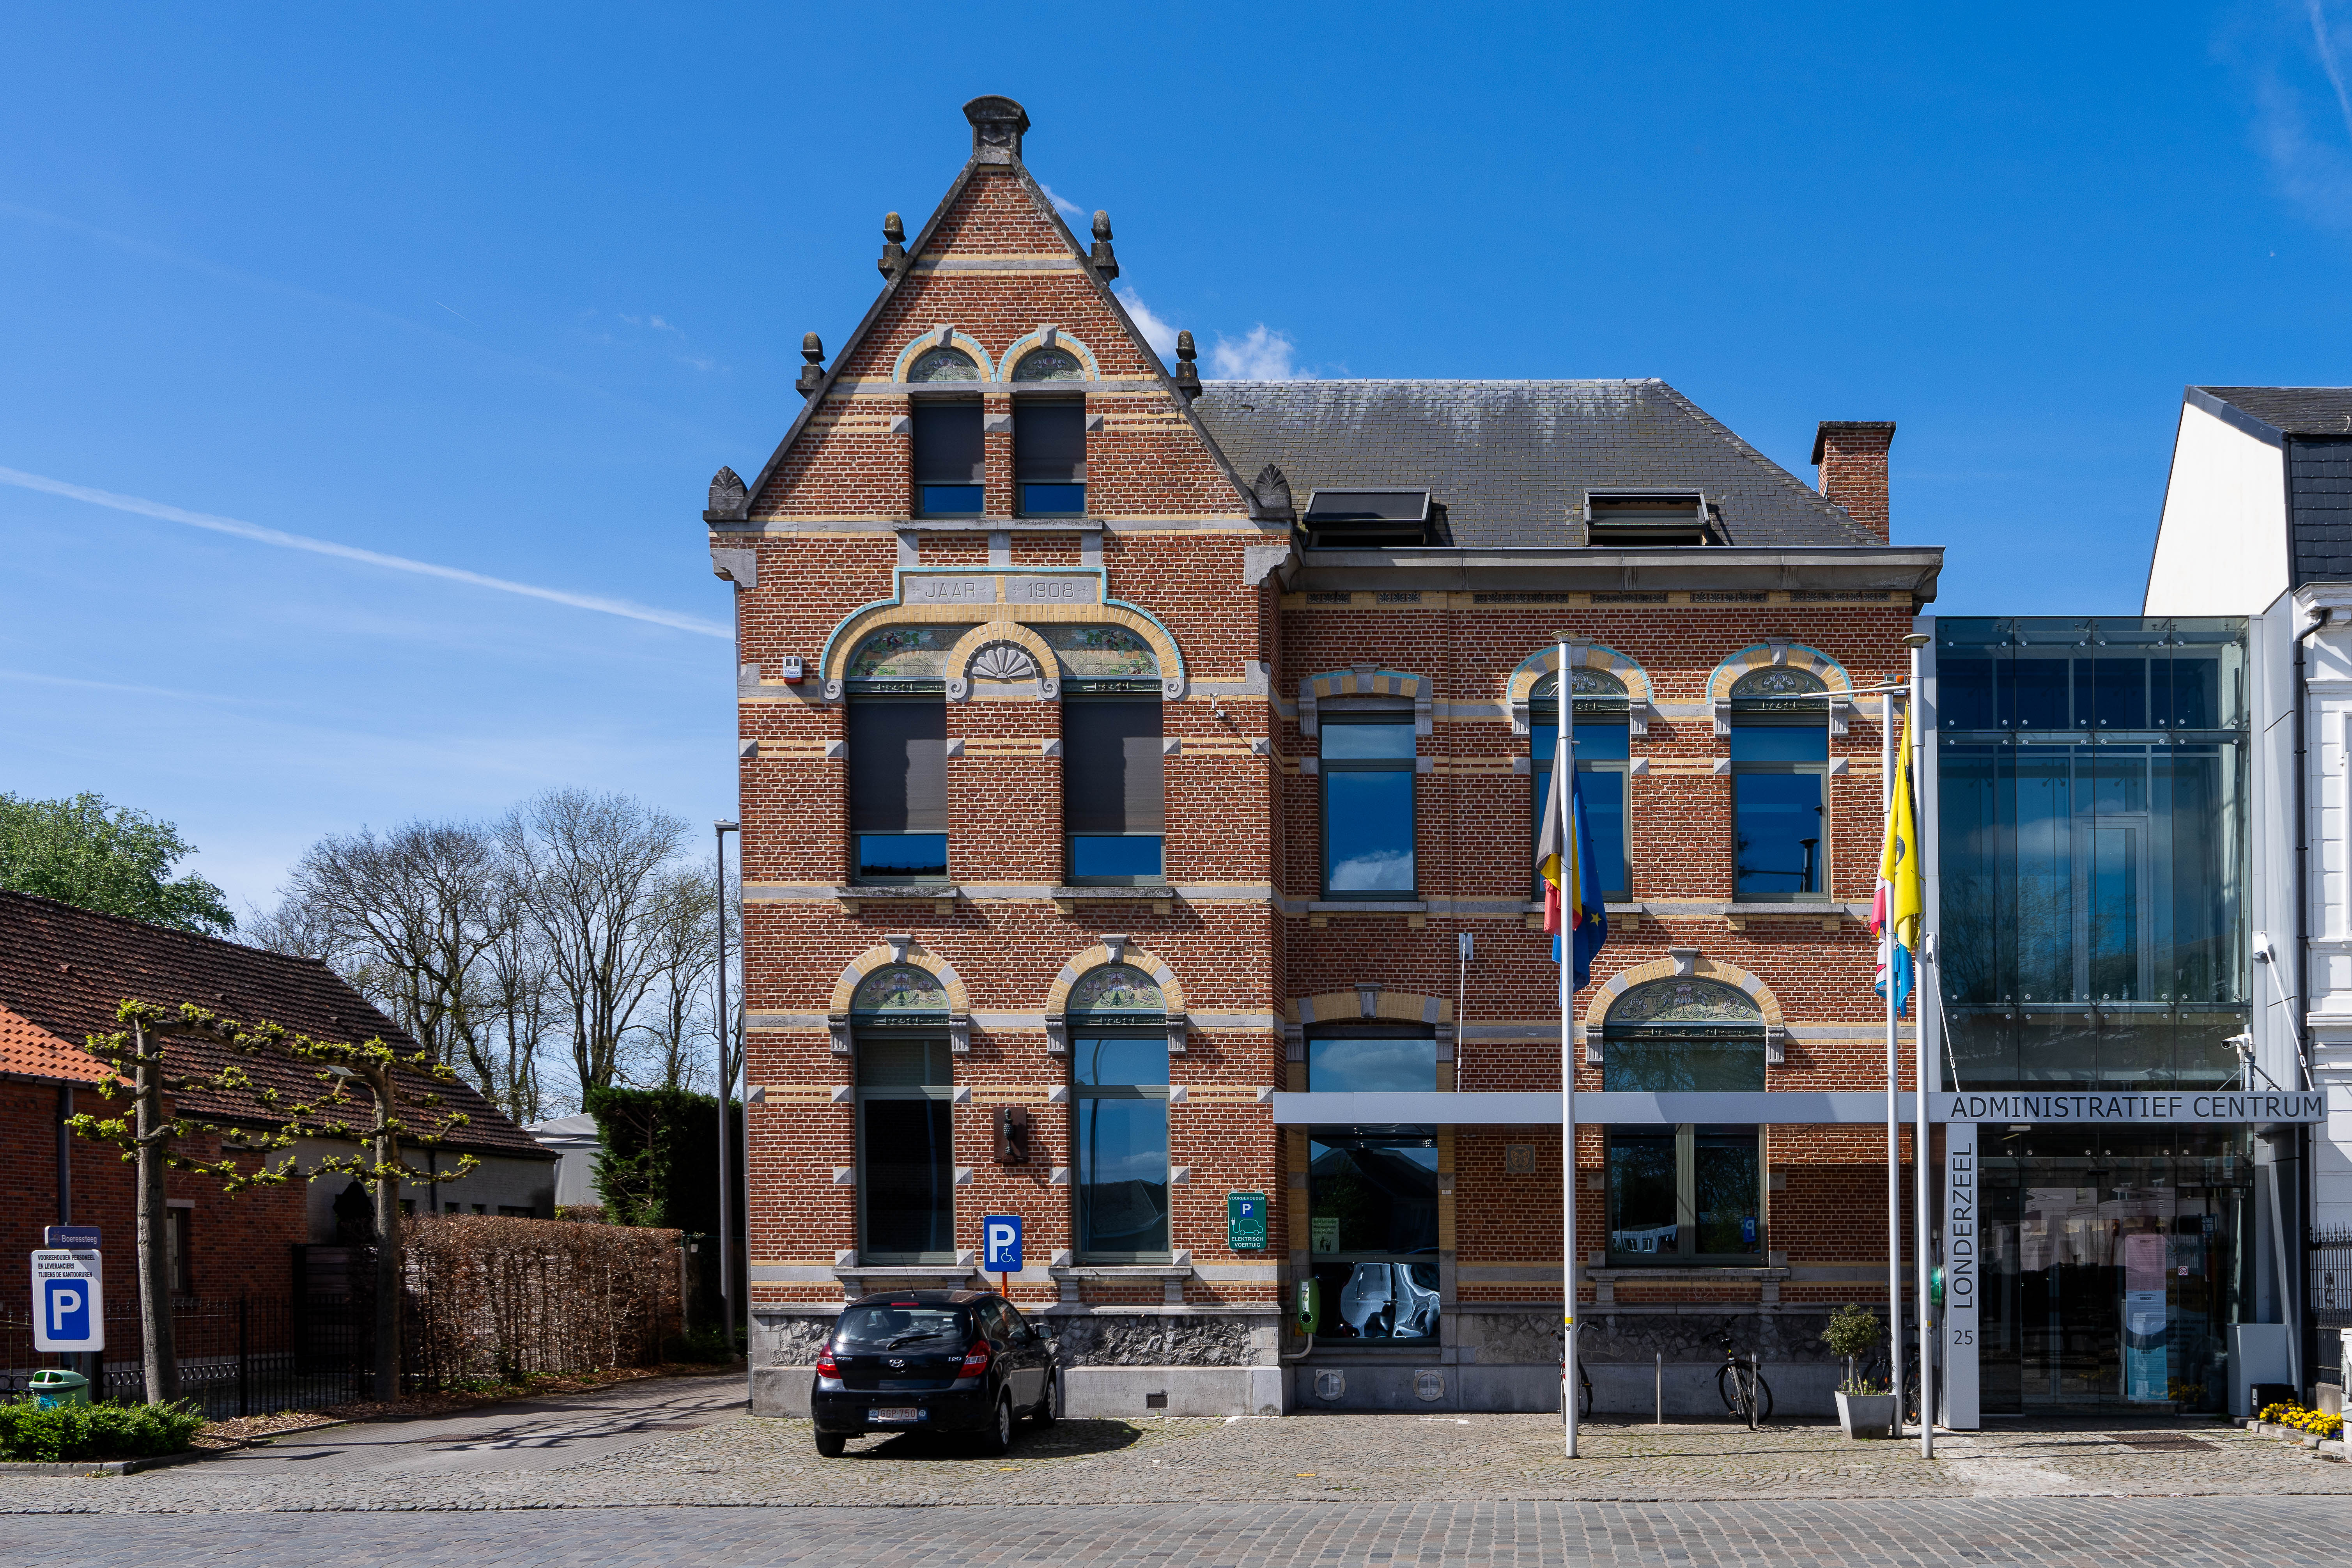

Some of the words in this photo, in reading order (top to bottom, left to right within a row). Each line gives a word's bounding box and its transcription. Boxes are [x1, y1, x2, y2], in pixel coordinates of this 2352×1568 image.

[925, 583, 976, 598] JAAR
[1028, 583, 1074, 598] 1908
[1950, 1096, 2182, 1118] ADMINISTRATIEF
[2193, 1096, 2322, 1118] CENTRUM
[1242, 1203, 1252, 1214] P
[1952, 1143, 1973, 1308] LONDERZEEL
[62, 1235, 97, 1244] Boeressteeg
[989, 1224, 1016, 1263] P
[53, 1289, 81, 1330] P
[1954, 1330, 1973, 1345] 25
